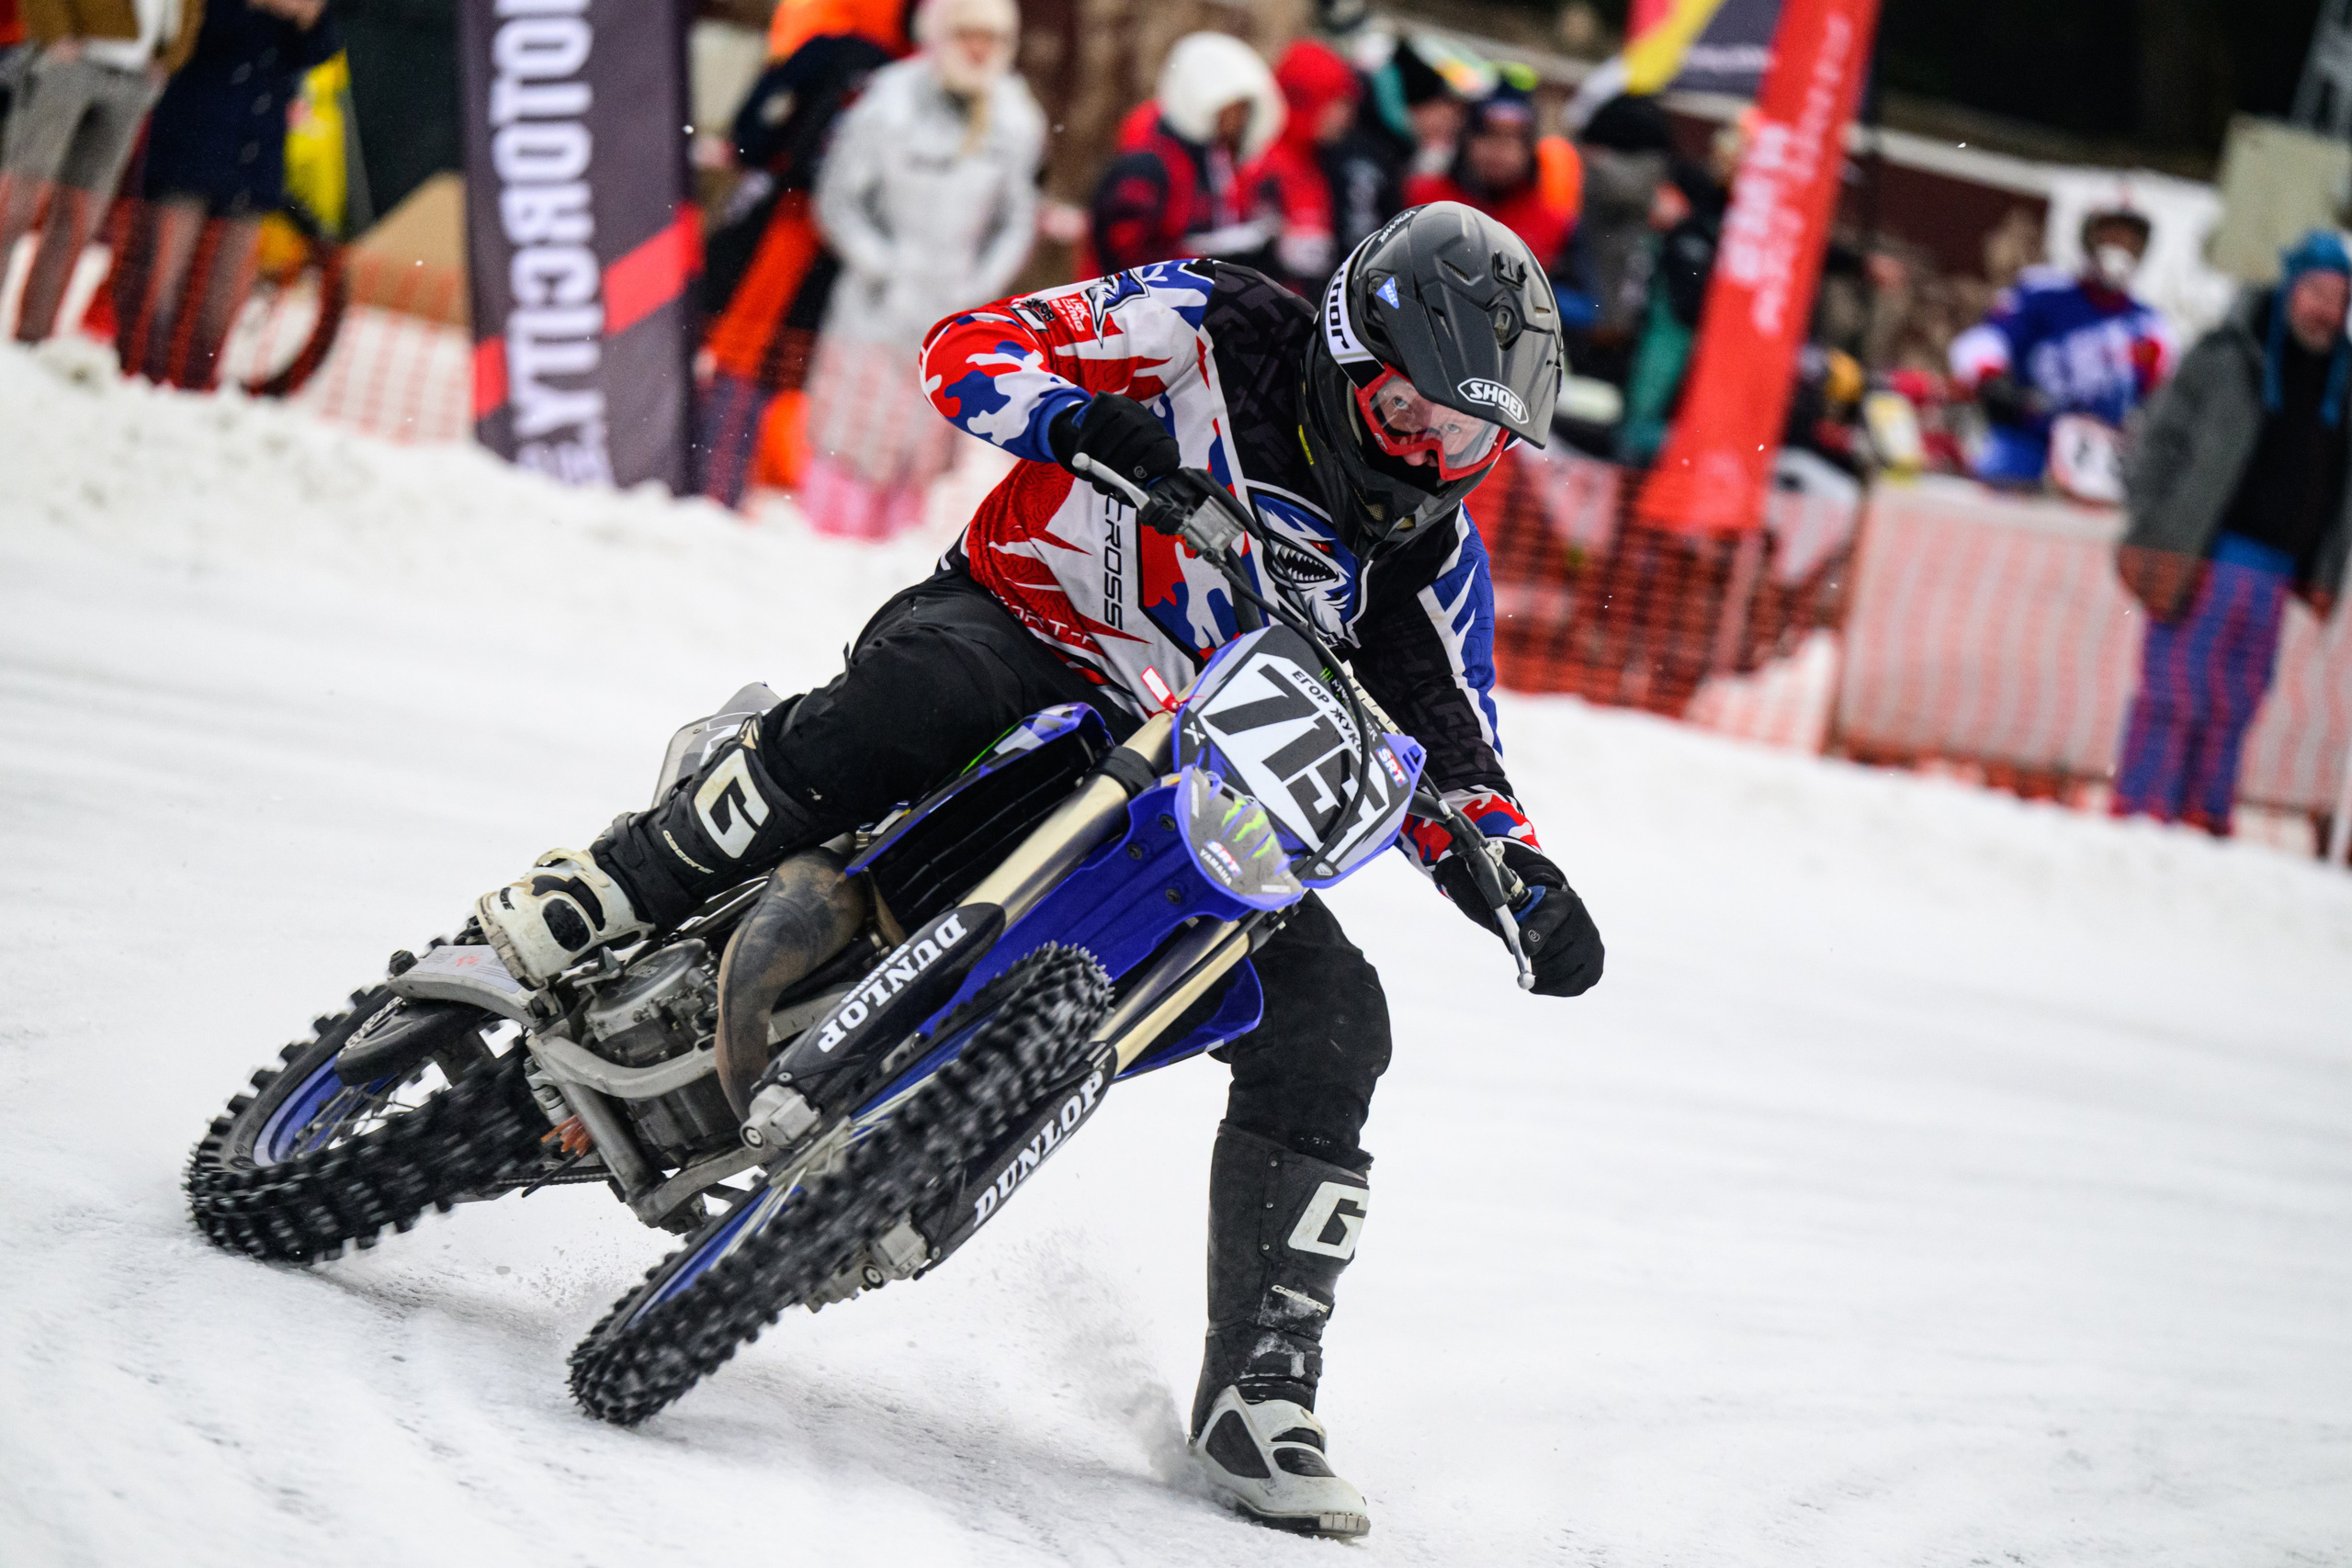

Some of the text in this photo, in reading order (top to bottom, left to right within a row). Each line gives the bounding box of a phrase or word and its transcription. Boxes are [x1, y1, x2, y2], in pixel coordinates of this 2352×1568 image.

[1470, 382, 1522, 420] SHOEI
[1203, 663, 1385, 842] 715
[1292, 671, 1330, 704] ЕГОР
[1329, 706, 1374, 762] ЖУКО
[1377, 747, 1407, 787] SRT
[1199, 849, 1232, 886] YAMAHA
[818, 913, 967, 1053] DUNLOP
[974, 1070, 1102, 1227] DUNLOP
